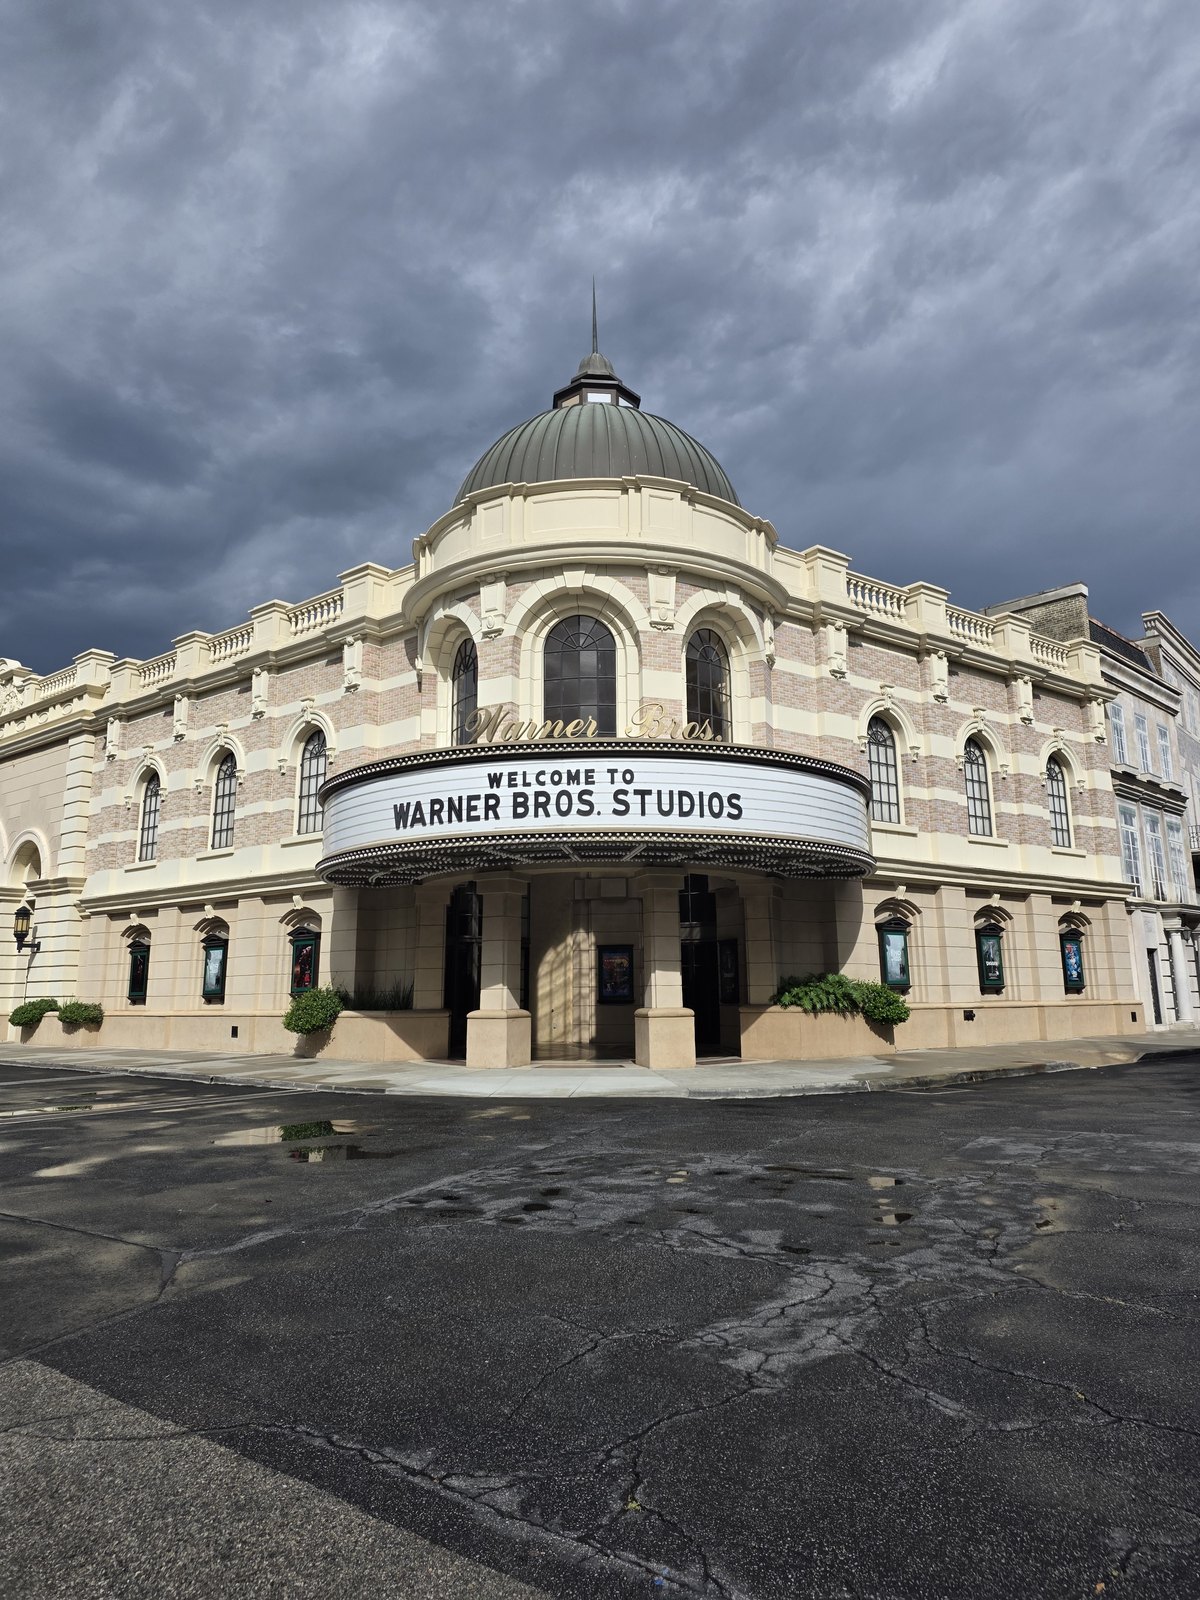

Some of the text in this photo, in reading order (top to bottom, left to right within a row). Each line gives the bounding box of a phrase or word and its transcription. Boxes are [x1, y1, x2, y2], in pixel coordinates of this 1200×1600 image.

[465, 703, 722, 743] Warner Bros.
[487, 768, 635, 789] WELCOME TO
[393, 788, 743, 830] WARNER BROS. STUDIOS
